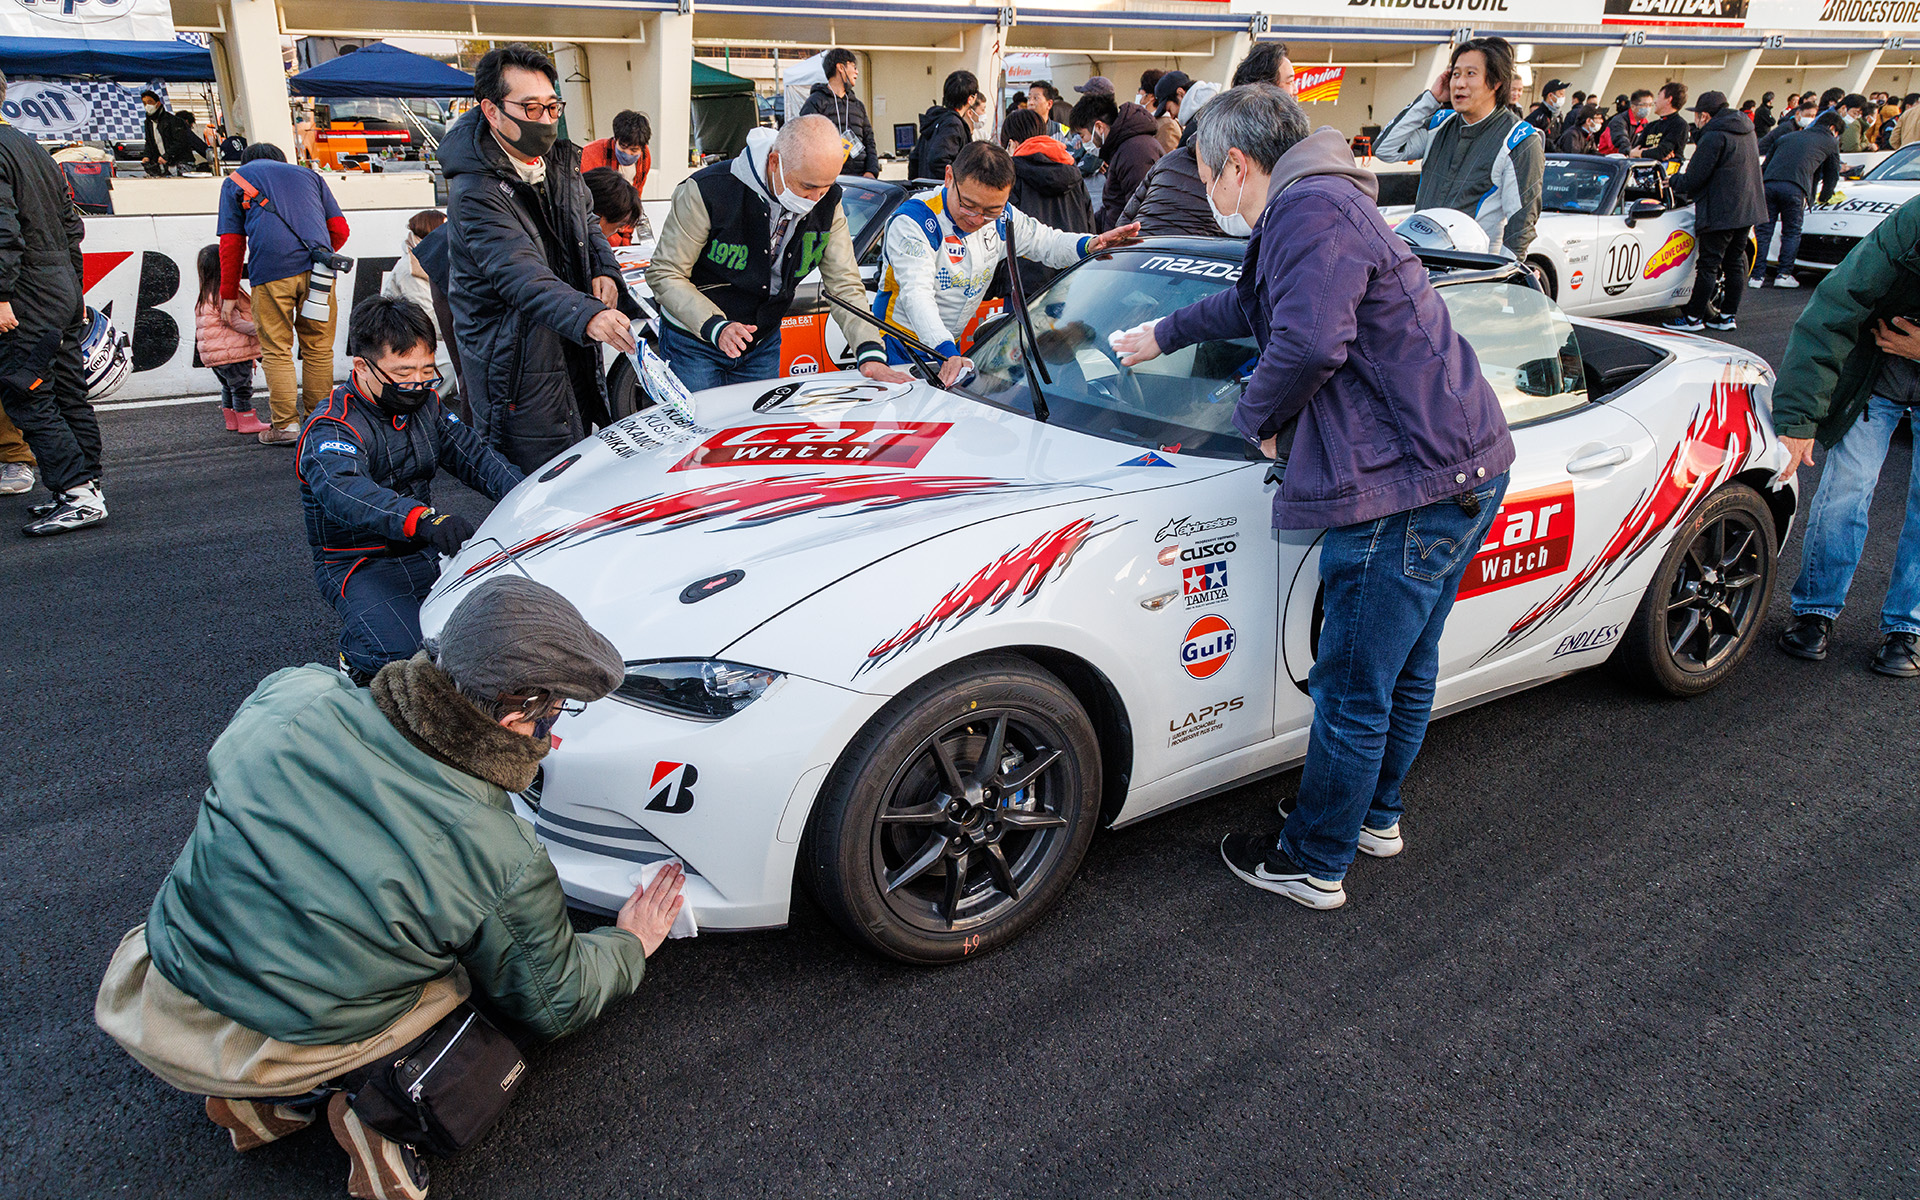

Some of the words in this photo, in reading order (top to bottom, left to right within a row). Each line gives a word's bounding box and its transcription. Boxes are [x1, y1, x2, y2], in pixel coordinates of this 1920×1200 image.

[1002, 7, 1014, 25] 19
[1256, 16, 1268, 32] 18
[1458, 28, 1472, 42] 17
[1631, 31, 1644, 45] 16
[1769, 35, 1783, 48] 15
[1889, 37, 1902, 49] 14
[706, 239, 749, 271] 1972
[1608, 242, 1641, 284] 100
[1661, 246, 1676, 262] LOVE
[797, 315, 814, 325] E&T
[790, 364, 818, 375] Gulf
[721, 424, 919, 447] Car
[731, 444, 871, 461] Watch
[1180, 540, 1237, 562] CUSCO
[1480, 545, 1549, 583] Watch
[1184, 588, 1229, 607] TAMIYA
[1182, 633, 1235, 662] Gulf
[1553, 621, 1624, 656] ENDLESS
[1169, 695, 1245, 732] LAPPS
